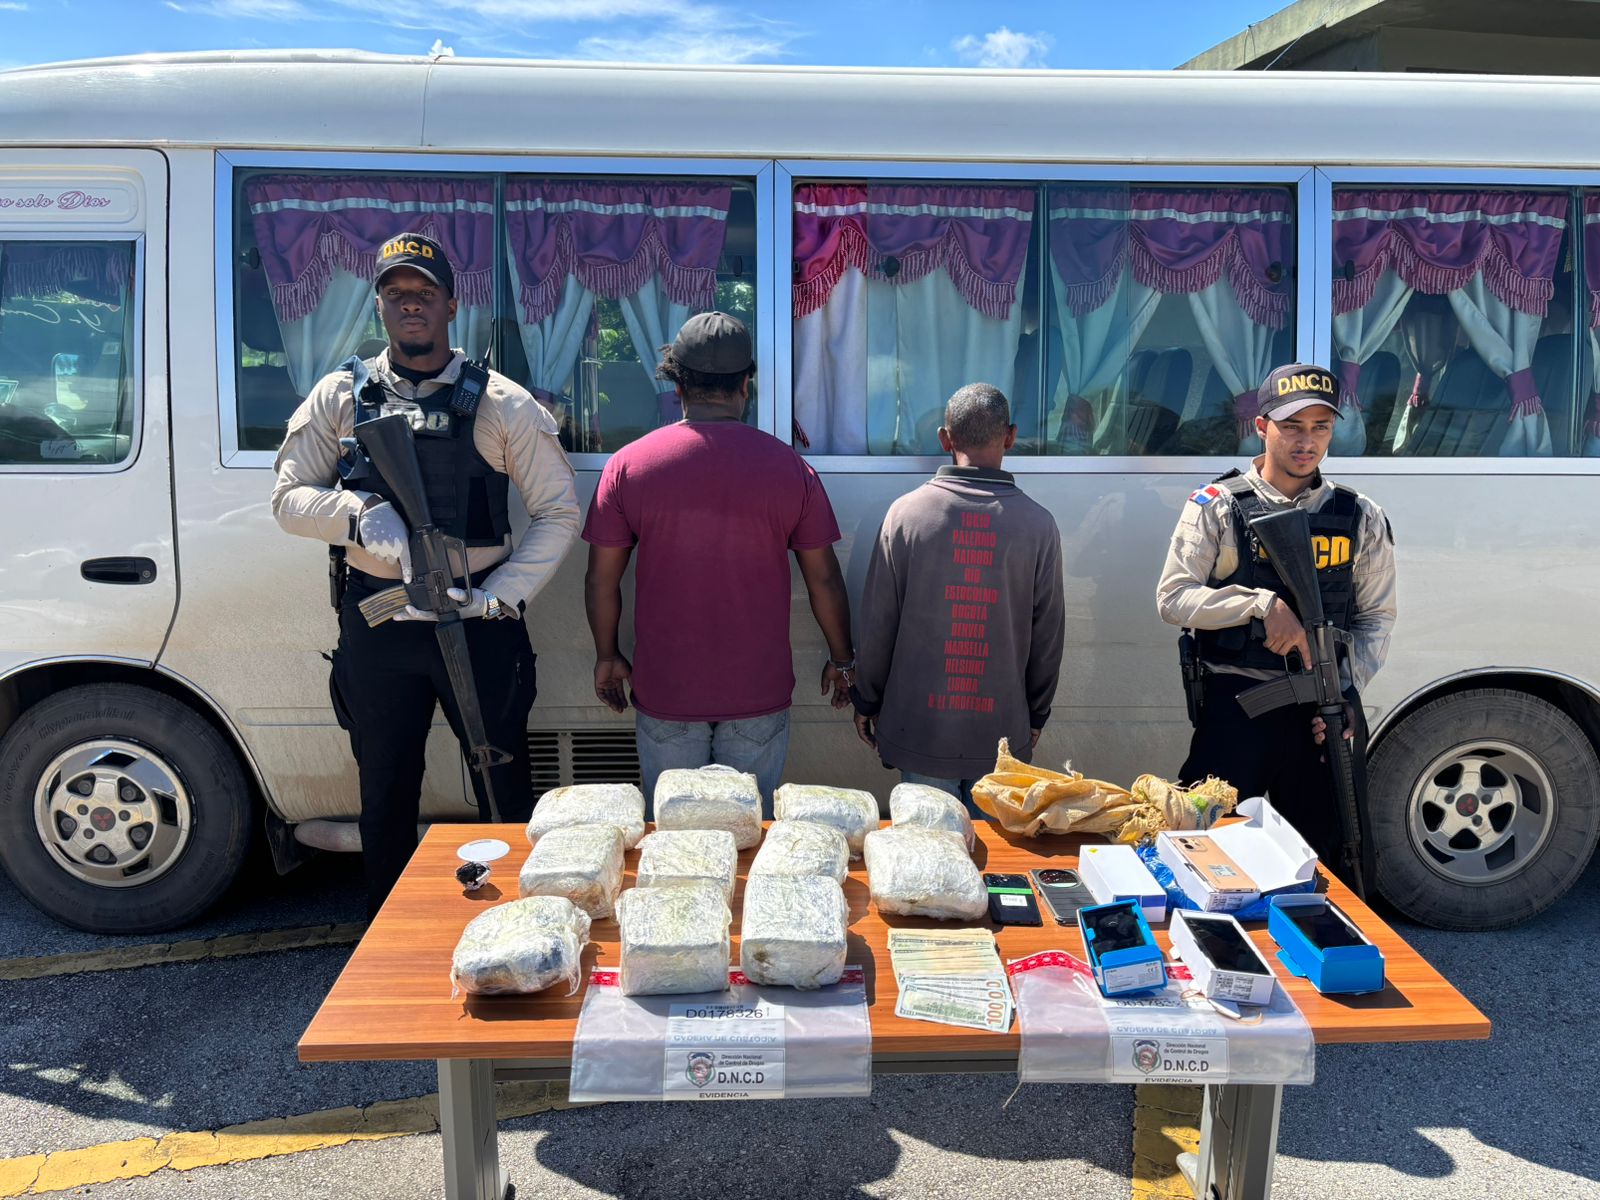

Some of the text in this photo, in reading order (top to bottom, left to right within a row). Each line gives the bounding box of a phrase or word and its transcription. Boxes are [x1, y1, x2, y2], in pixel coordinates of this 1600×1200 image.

[15, 194, 54, 208] solo
[57, 190, 111, 210] Dios
[1164, 1060, 1209, 1072] D.N.C.D
[718, 1072, 765, 1084] D.N.C.D
